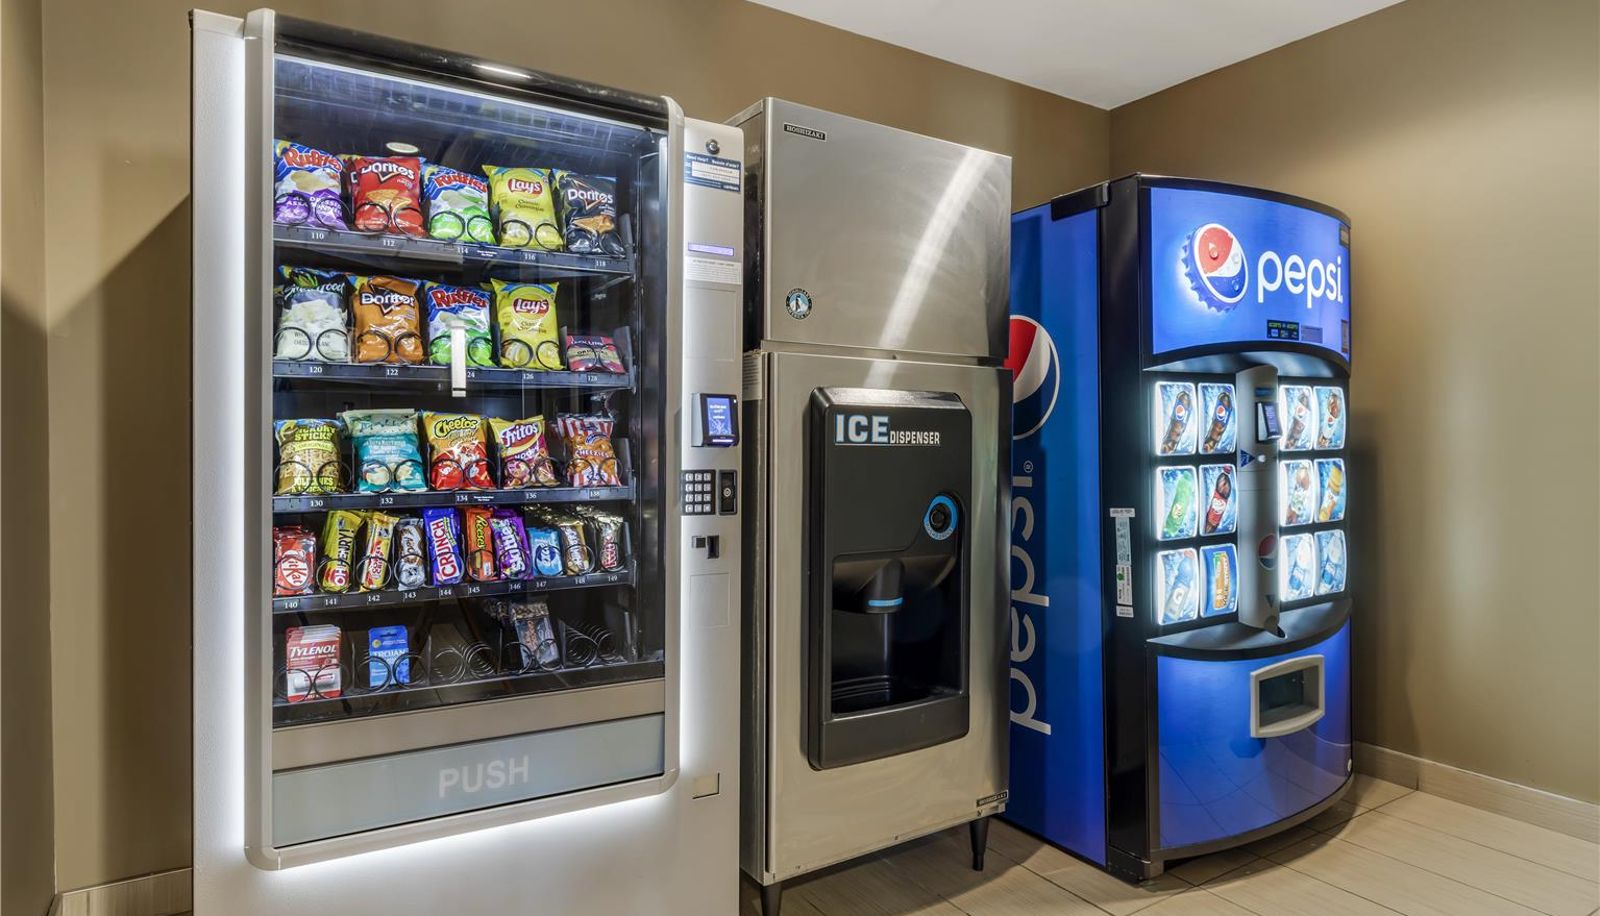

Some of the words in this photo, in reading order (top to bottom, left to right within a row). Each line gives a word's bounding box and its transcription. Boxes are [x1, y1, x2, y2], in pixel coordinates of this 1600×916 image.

[283, 147, 342, 172] Ruffles
[361, 163, 415, 180] Doritos
[433, 173, 488, 193] Ruffles
[567, 188, 613, 204] Doritos
[311, 232, 325, 240] 110
[382, 239, 396, 247] 112
[457, 247, 469, 255] 114
[1257, 250, 1343, 309] pepsi
[361, 293, 415, 307] Doritos
[431, 289, 488, 308] Ruffles
[514, 298, 549, 314] Lay's
[309, 366, 323, 374] 120
[386, 368, 399, 376] 122
[522, 373, 535, 381] 126
[434, 416, 479, 437] Cheetos
[836, 414, 889, 443] ICE
[890, 430, 940, 445] DISPENSER
[294, 432, 333, 441] STICKS
[501, 423, 539, 447] Fritos
[381, 497, 393, 505] 132
[337, 528, 354, 568] HENRY!
[432, 518, 458, 578] CRUNCH
[334, 569, 347, 586] OH
[440, 589, 452, 597] 144
[289, 644, 337, 659] TYLENOL
[439, 755, 529, 799] PUSH
